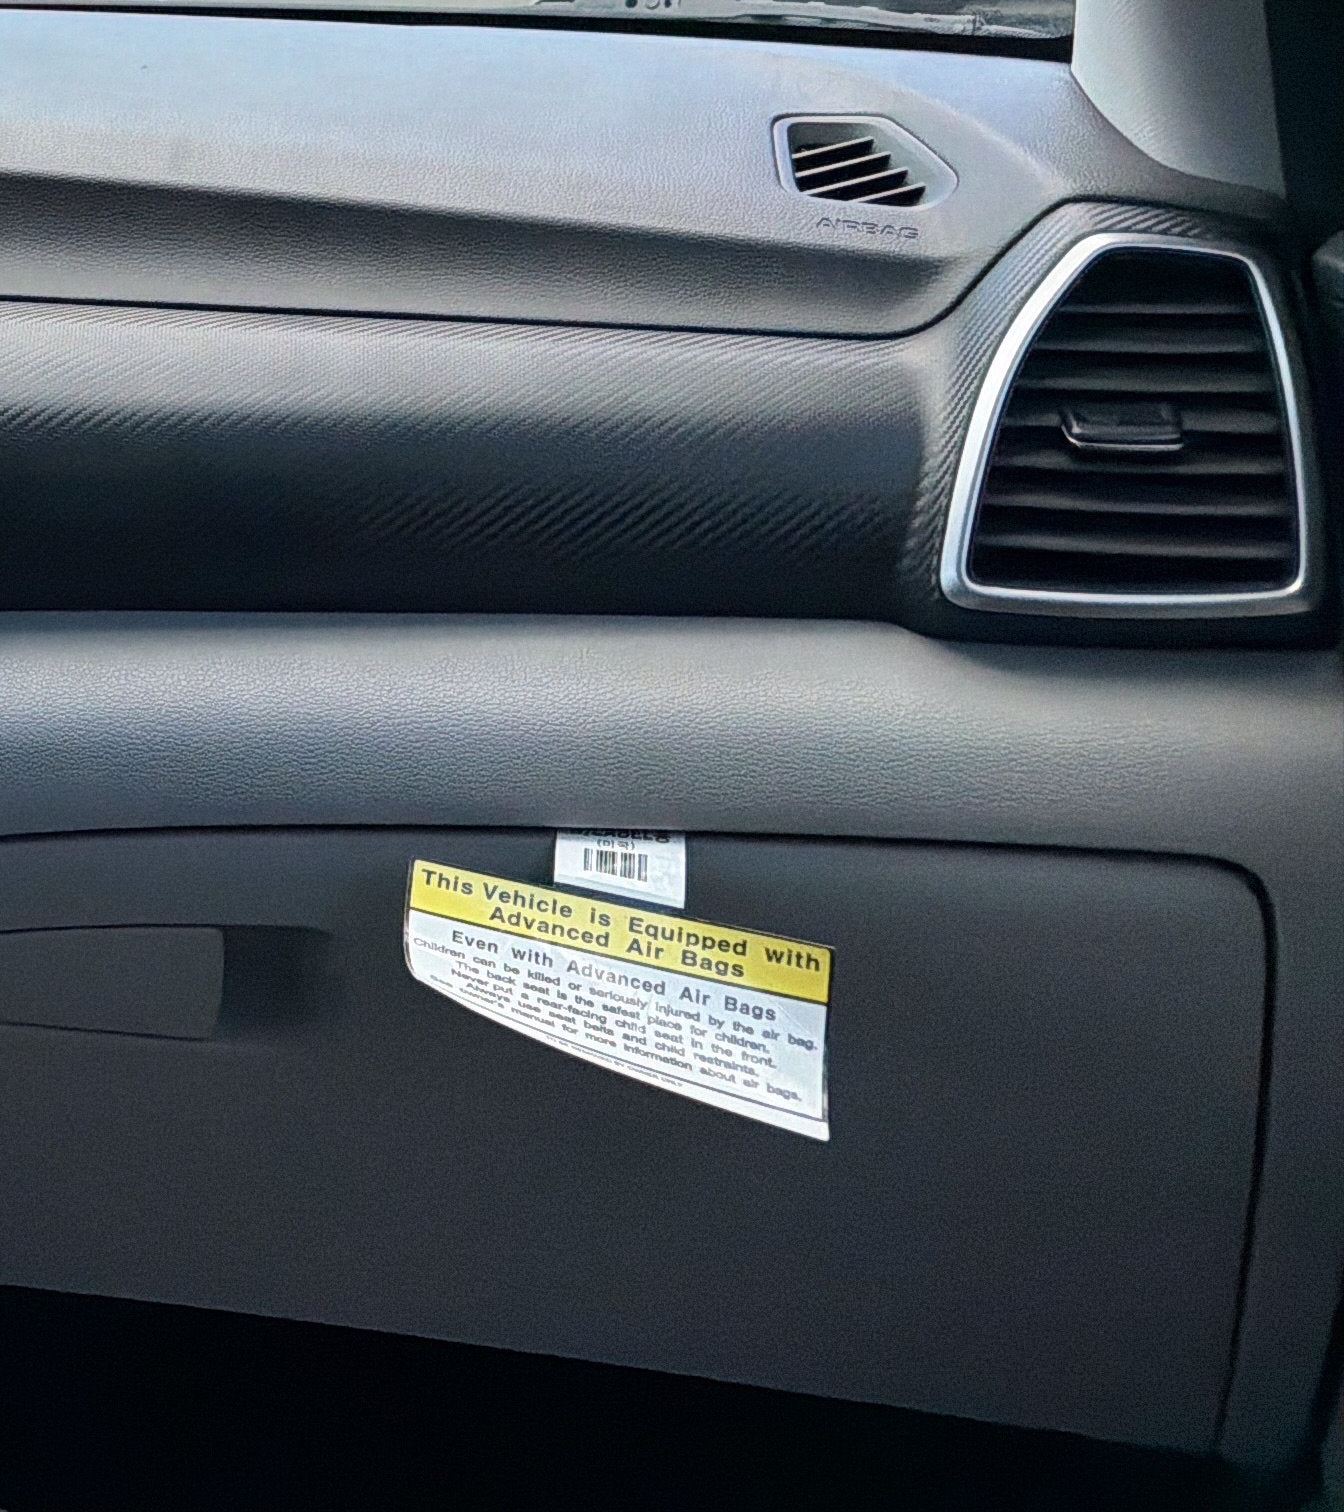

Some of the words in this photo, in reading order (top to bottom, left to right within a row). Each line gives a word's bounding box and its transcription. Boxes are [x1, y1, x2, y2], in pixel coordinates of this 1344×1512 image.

[816, 217, 920, 239] AIRBAG
[422, 869, 473, 895] This
[483, 882, 572, 918] Vehicle
[590, 907, 611, 927] is
[628, 916, 747, 956] Equipped
[765, 946, 820, 971] with
[489, 906, 609, 948] Advanced
[626, 938, 664, 959] Air
[681, 949, 744, 977] Bags
[413, 937, 465, 959] Children
[473, 956, 496, 968] can
[504, 963, 520, 975] be
[527, 969, 560, 986] killed
[568, 982, 582, 991] or
[589, 987, 648, 1010] seriously
[655, 1002, 700, 1022] injured
[708, 1015, 725, 1029] by
[733, 1021, 754, 1035] the
[762, 1029, 780, 1040] air
[788, 1033, 818, 1051] bag.
[451, 969, 489, 986] Never
[537, 997, 607, 1024] rear-facing
[615, 1019, 647, 1034] child
[654, 1030, 683, 1044] seat
[691, 1038, 703, 1049] in
[711, 1044, 732, 1057] the
[452, 930, 498, 954] Even
[512, 947, 553, 968] with
[567, 960, 665, 996] Advanced
[679, 986, 711, 1006] Air
[724, 995, 776, 1021] Bags
[456, 960, 480, 974] The
[487, 970, 517, 986] back
[575, 995, 594, 1007] the
[602, 1004, 640, 1020] safest
[647, 1015, 682, 1031] place
[690, 1025, 707, 1037] for
[622, 1033, 647, 1045] and
[654, 1042, 686, 1057] child
